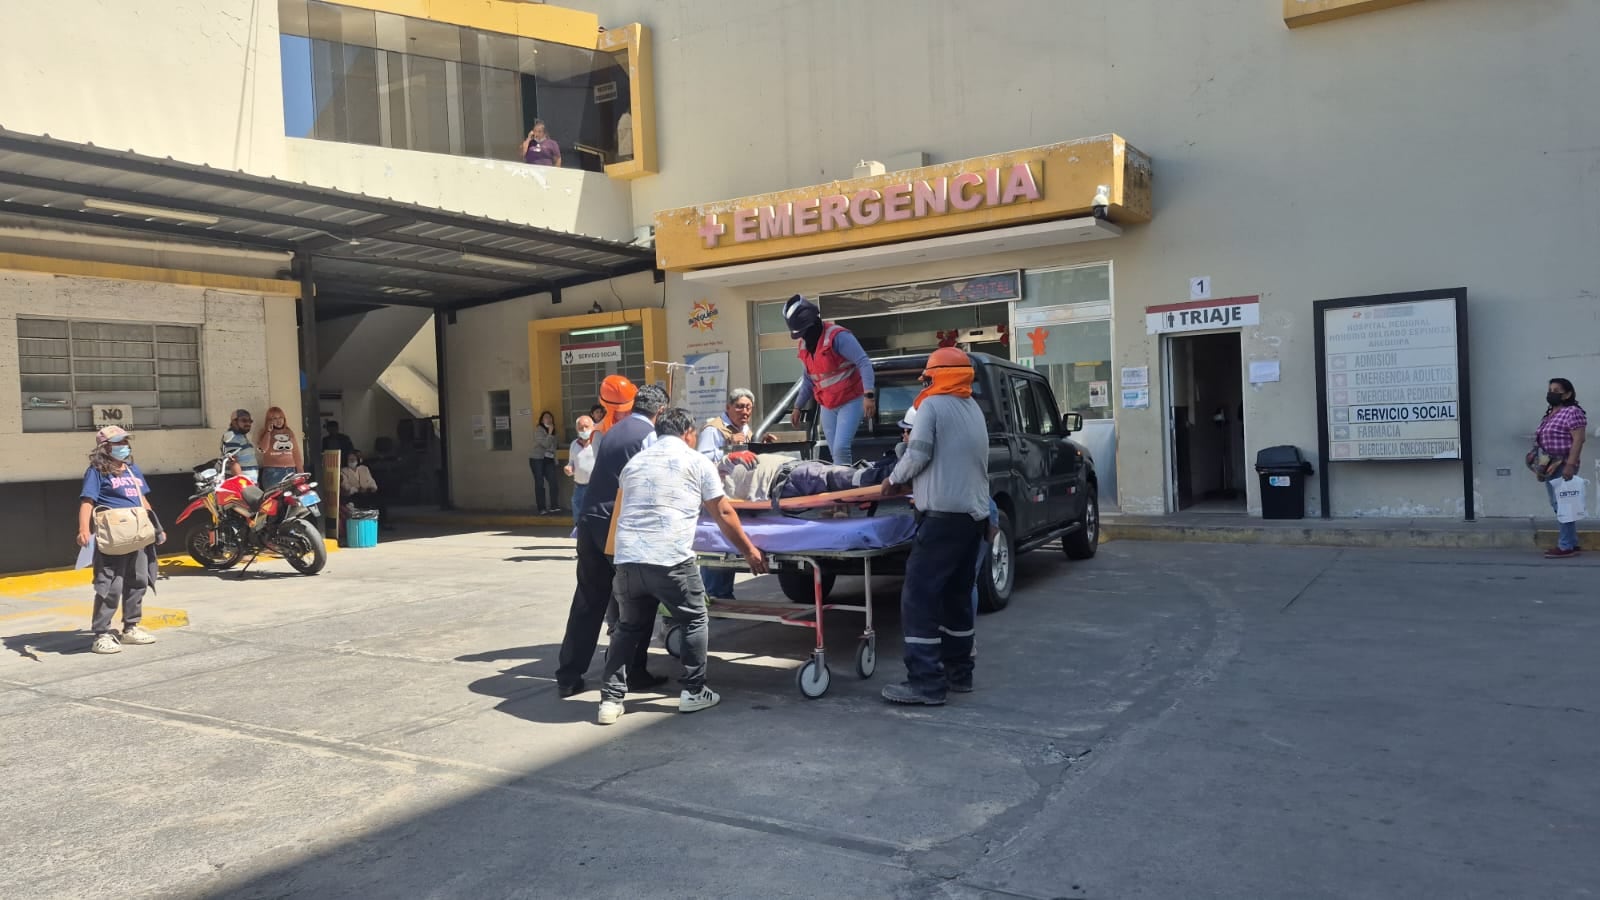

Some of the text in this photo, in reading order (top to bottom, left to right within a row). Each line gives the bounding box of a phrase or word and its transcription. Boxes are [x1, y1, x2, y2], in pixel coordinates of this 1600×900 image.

[734, 162, 1042, 243] EMERGENCIA
[1196, 279, 1204, 294] 1
[1179, 306, 1242, 326] TRIAJE
[1347, 319, 1431, 331] HOSPITAL REGIONAL
[1368, 329, 1407, 338] DELGADO
[1368, 338, 1409, 347] AREQUIPA
[1355, 352, 1397, 368] ADMISION
[1355, 367, 1453, 385] EMERGENCIA ADULTOS
[1356, 386, 1453, 403] EMERGENCIA PEDIATRICA
[101, 409, 123, 420] NO
[1357, 405, 1455, 421] SERVICIO SOCIAL
[1358, 424, 1401, 438] FARMACIA
[1358, 442, 1398, 456] EMERGENCIA
